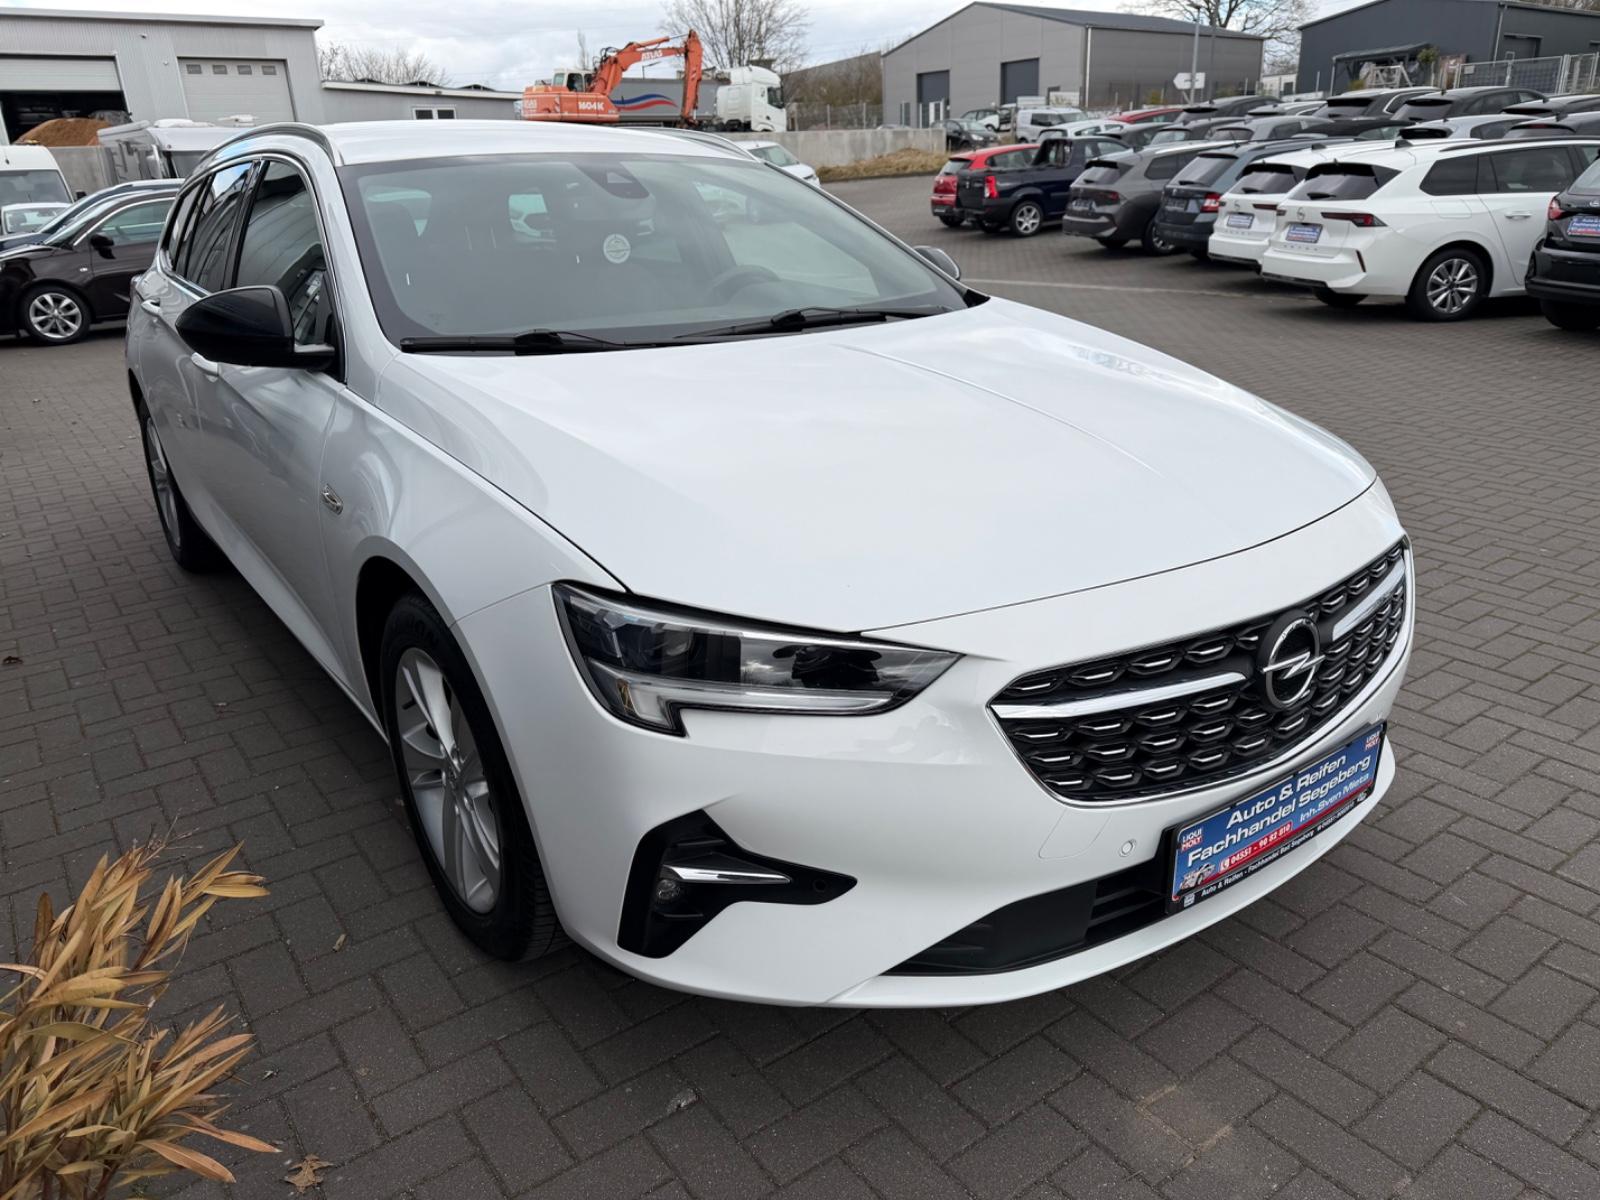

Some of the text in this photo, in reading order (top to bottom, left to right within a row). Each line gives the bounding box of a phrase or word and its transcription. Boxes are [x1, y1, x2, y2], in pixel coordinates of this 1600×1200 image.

[1187, 798, 1296, 867] Fachhandel
[1298, 755, 1371, 807] Segeberg
[1226, 755, 1347, 829] Auto & Reifen
[1182, 827, 1202, 843] LIQUI
[1201, 885, 1217, 897] Auto
[1224, 871, 1244, 885] Reifen
